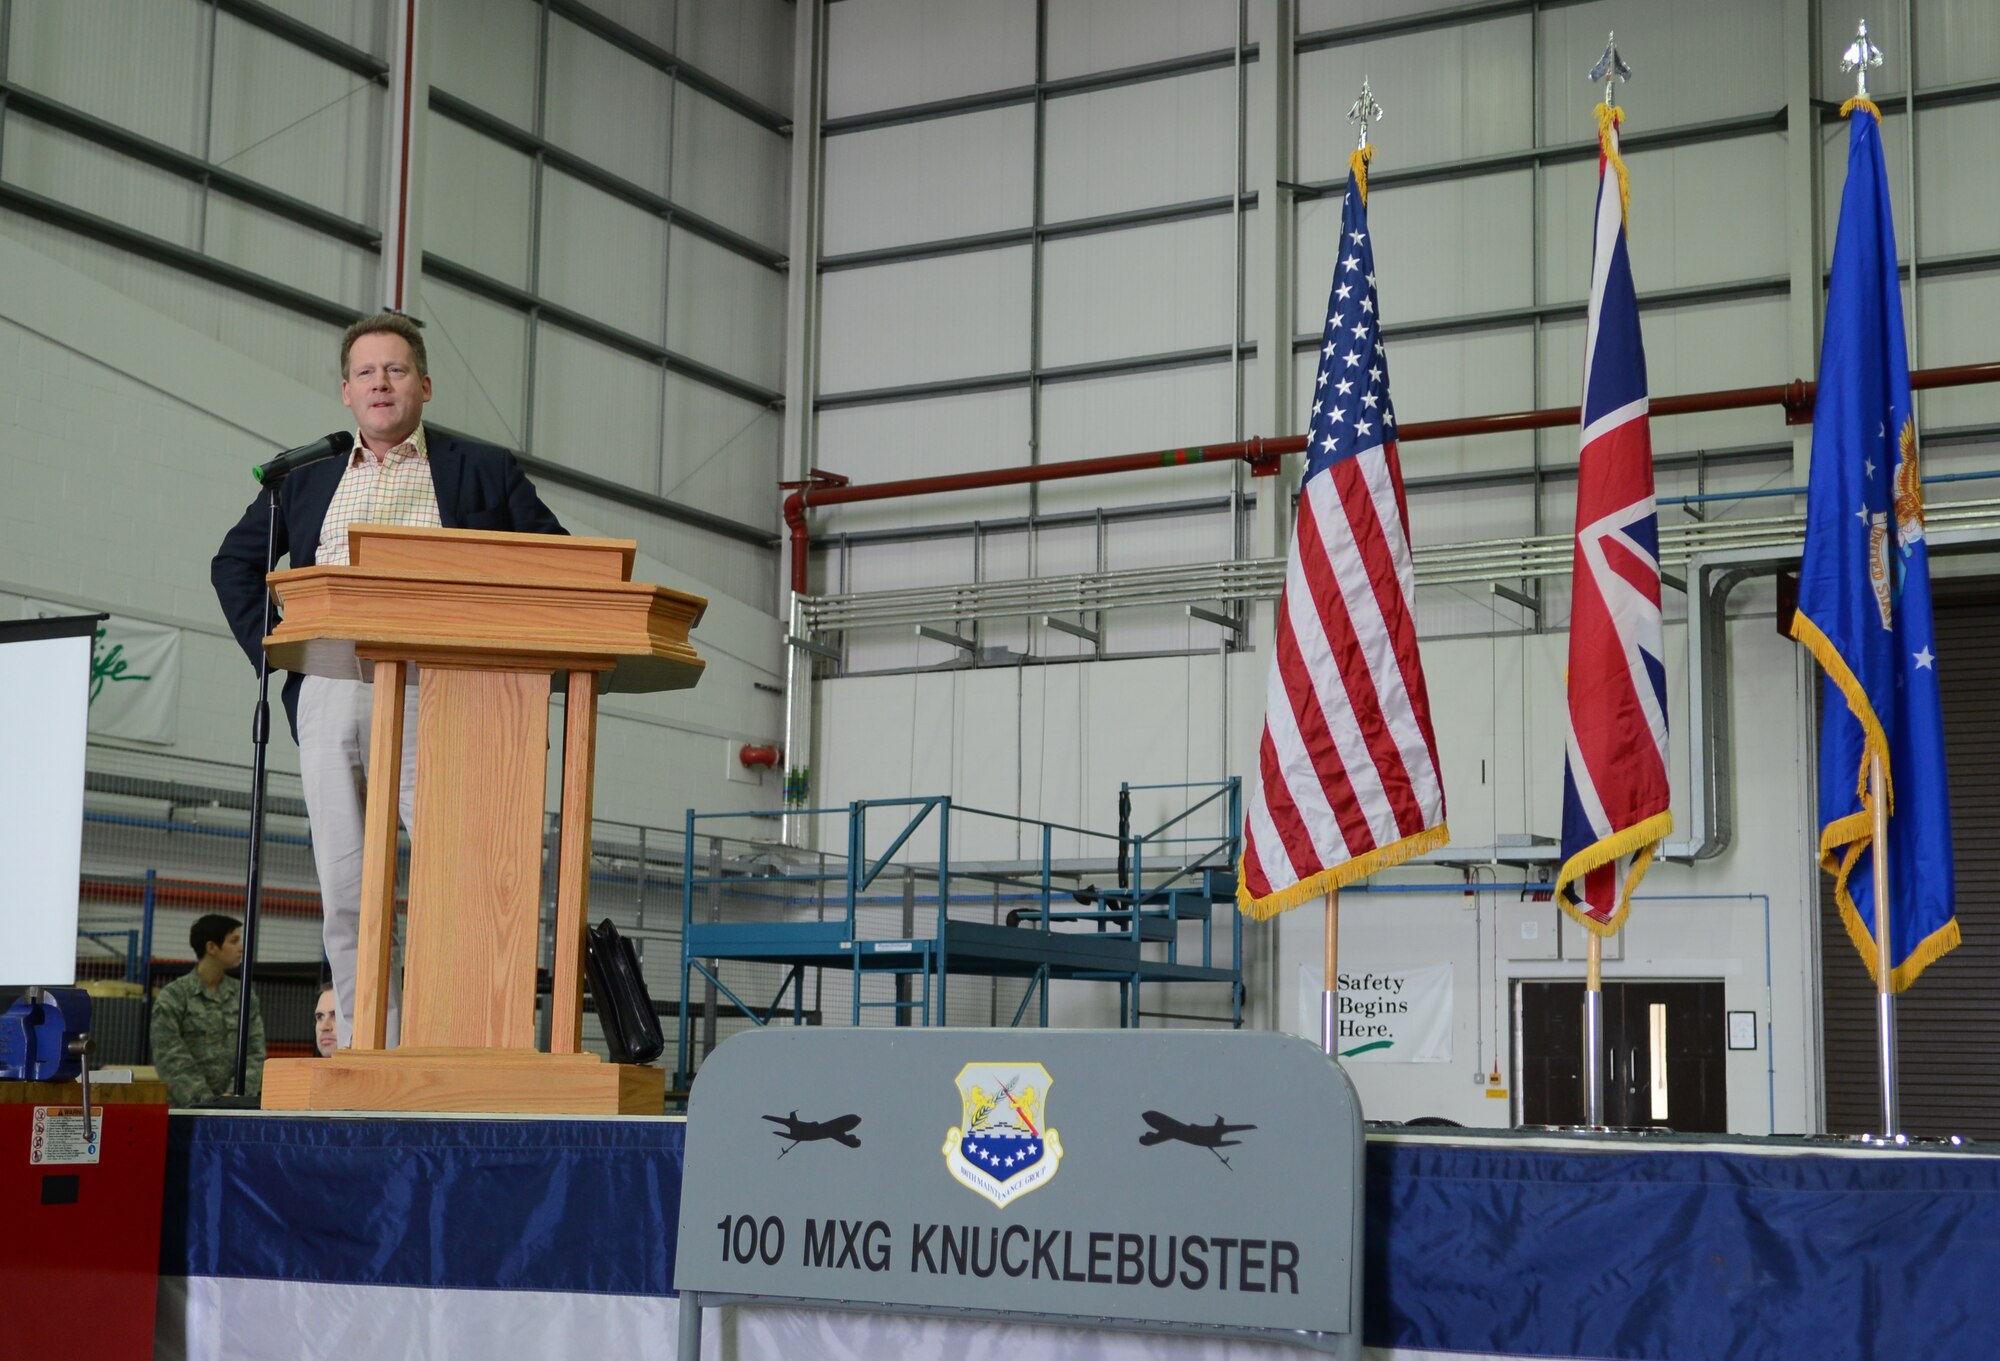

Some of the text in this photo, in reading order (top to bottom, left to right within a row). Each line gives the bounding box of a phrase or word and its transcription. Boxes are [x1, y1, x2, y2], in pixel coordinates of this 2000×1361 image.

[1871, 526, 1885, 580] UNITED
[1338, 973, 1404, 995] Safety
[1339, 996, 1408, 1018] Begins
[1340, 1019, 1394, 1038] Here.
[1025, 1166, 1046, 1184] GROUP
[717, 1214, 1300, 1295] 100 MXG KNUCKLEBUSTER
